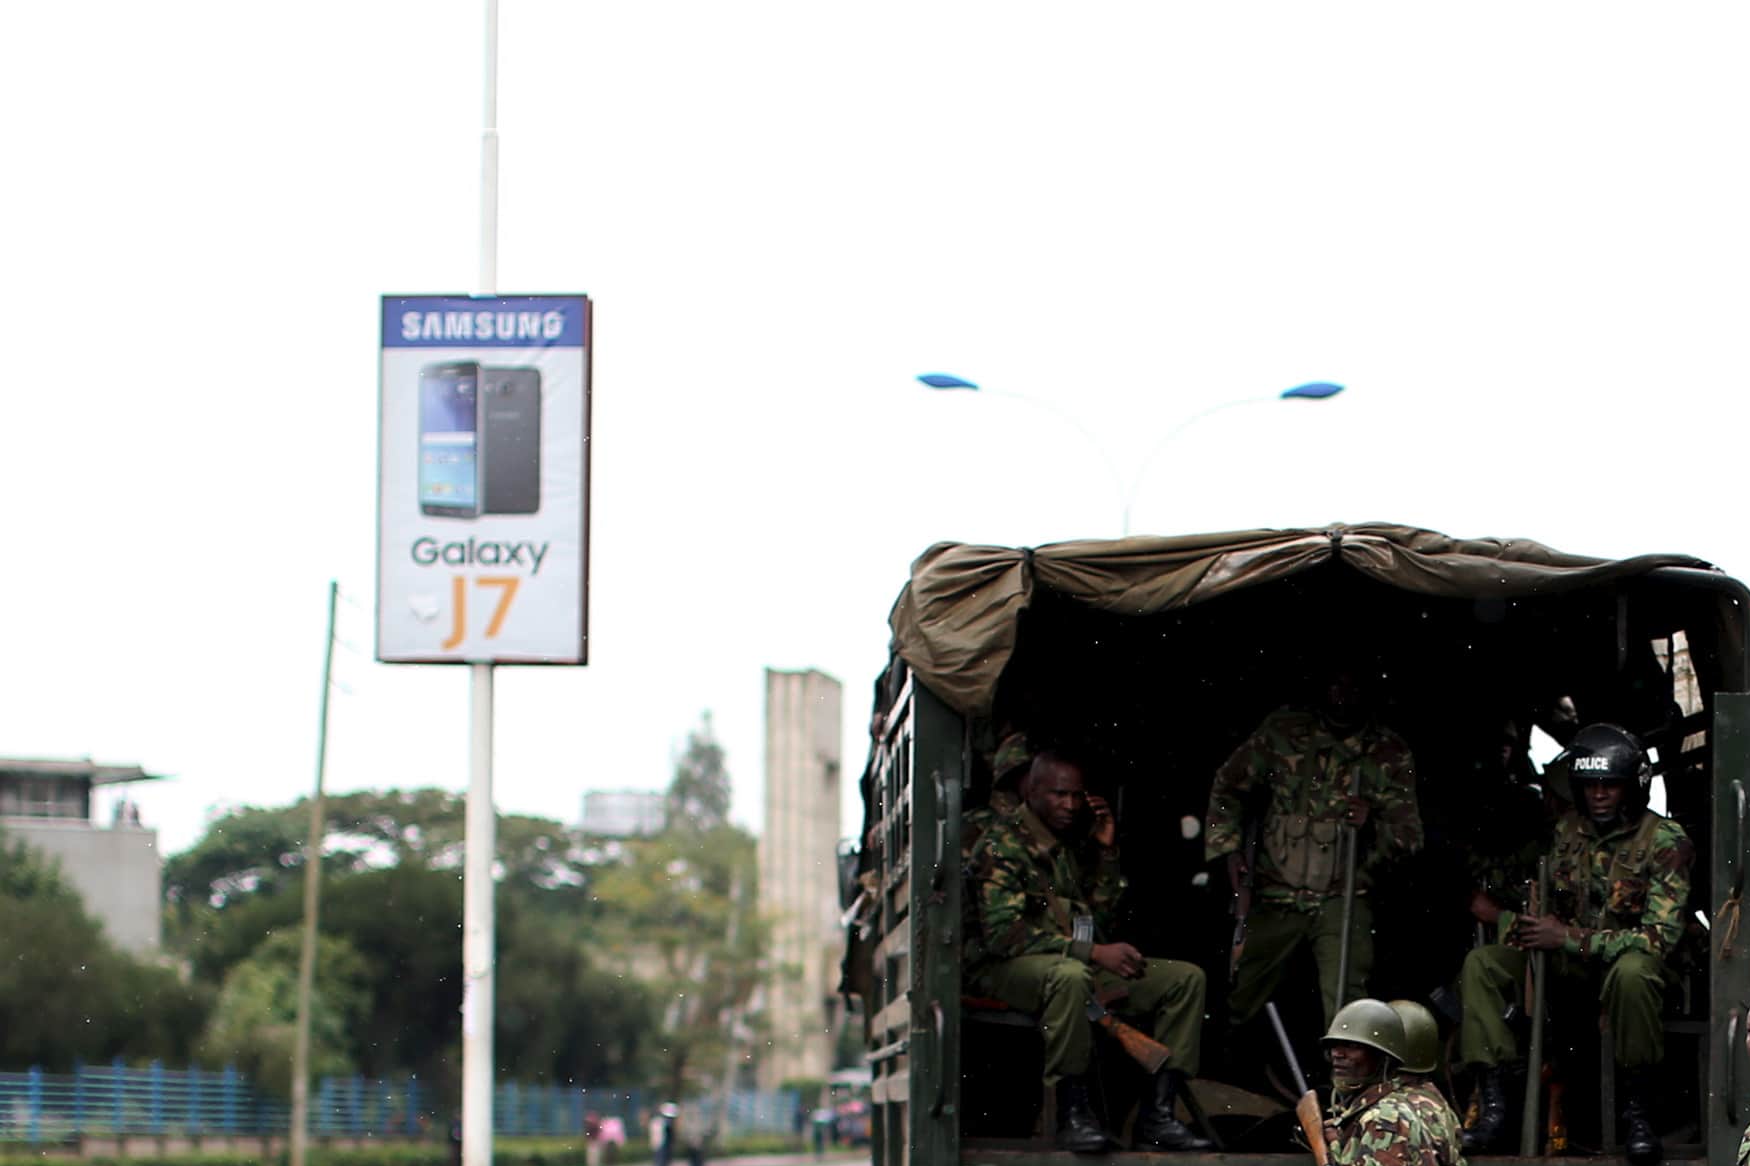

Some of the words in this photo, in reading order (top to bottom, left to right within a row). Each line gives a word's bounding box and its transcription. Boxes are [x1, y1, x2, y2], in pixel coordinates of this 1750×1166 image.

[401, 311, 564, 340] SAMSUNG
[410, 535, 550, 576] Galaxy
[441, 575, 521, 651] J7
[1574, 756, 1609, 771] POLICE
